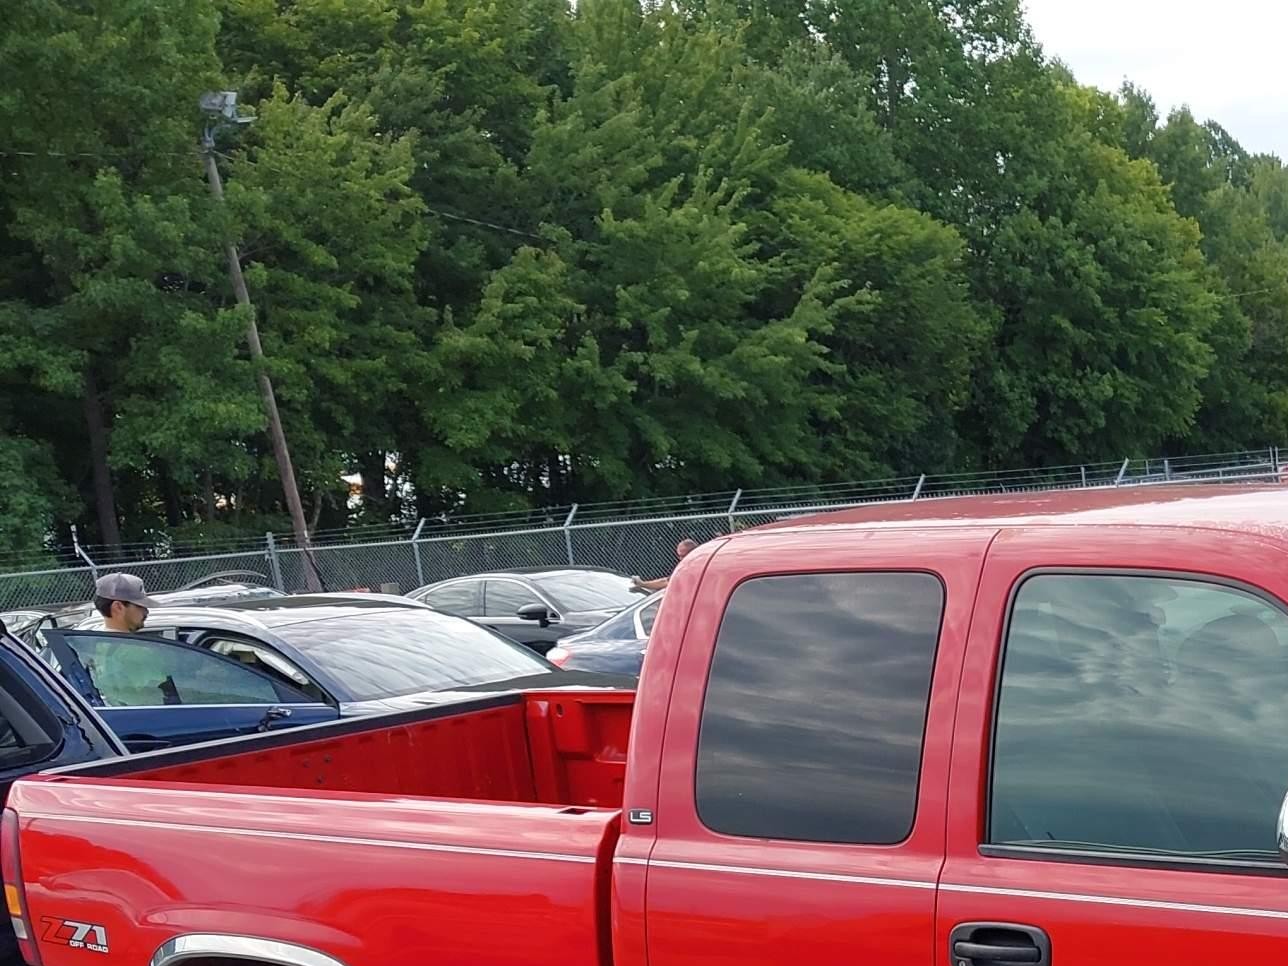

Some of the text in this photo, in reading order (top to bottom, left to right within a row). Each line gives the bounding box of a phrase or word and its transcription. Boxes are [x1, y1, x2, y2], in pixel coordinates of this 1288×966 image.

[630, 811, 652, 823] LS
[40, 915, 108, 946] Z71
[69, 940, 108, 953] OFF ROAD
